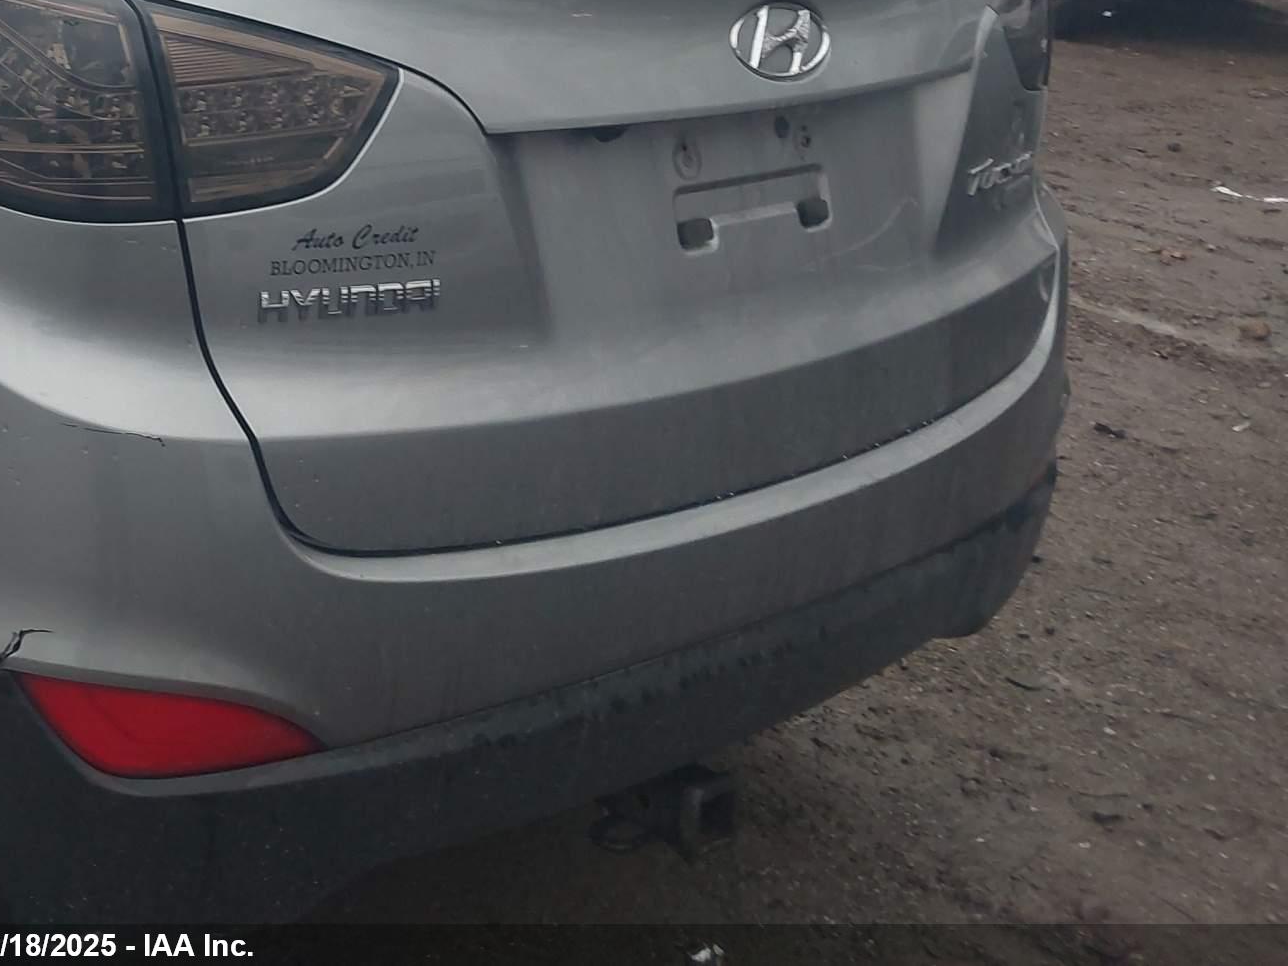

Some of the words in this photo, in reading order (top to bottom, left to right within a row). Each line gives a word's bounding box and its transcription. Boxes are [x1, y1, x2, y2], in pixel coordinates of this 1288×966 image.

[291, 228, 344, 251] Auto
[352, 224, 419, 250] Credit
[258, 278, 441, 323] HYUNDAI
